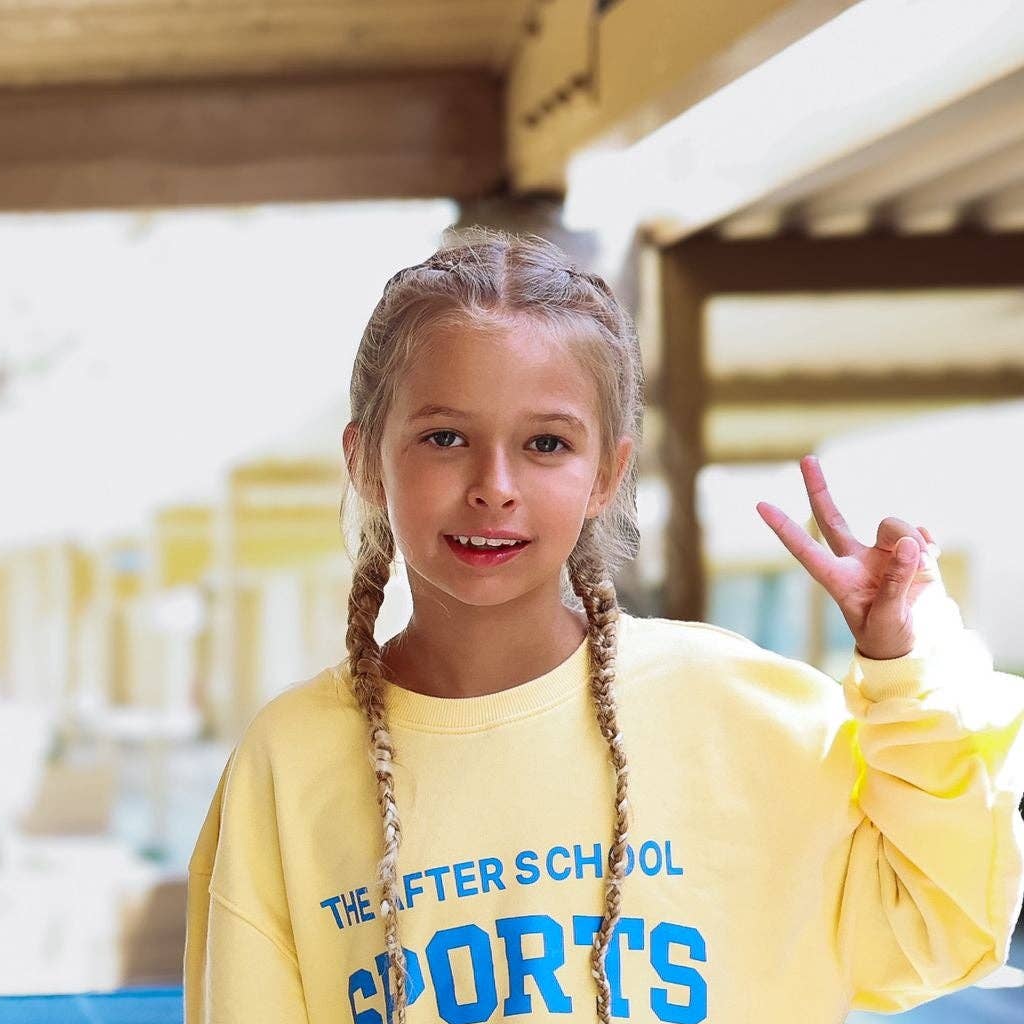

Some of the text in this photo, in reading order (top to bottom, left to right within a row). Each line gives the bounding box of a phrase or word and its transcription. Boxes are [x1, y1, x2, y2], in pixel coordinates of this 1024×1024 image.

[320, 840, 684, 930] THE FTER SCHOOL
